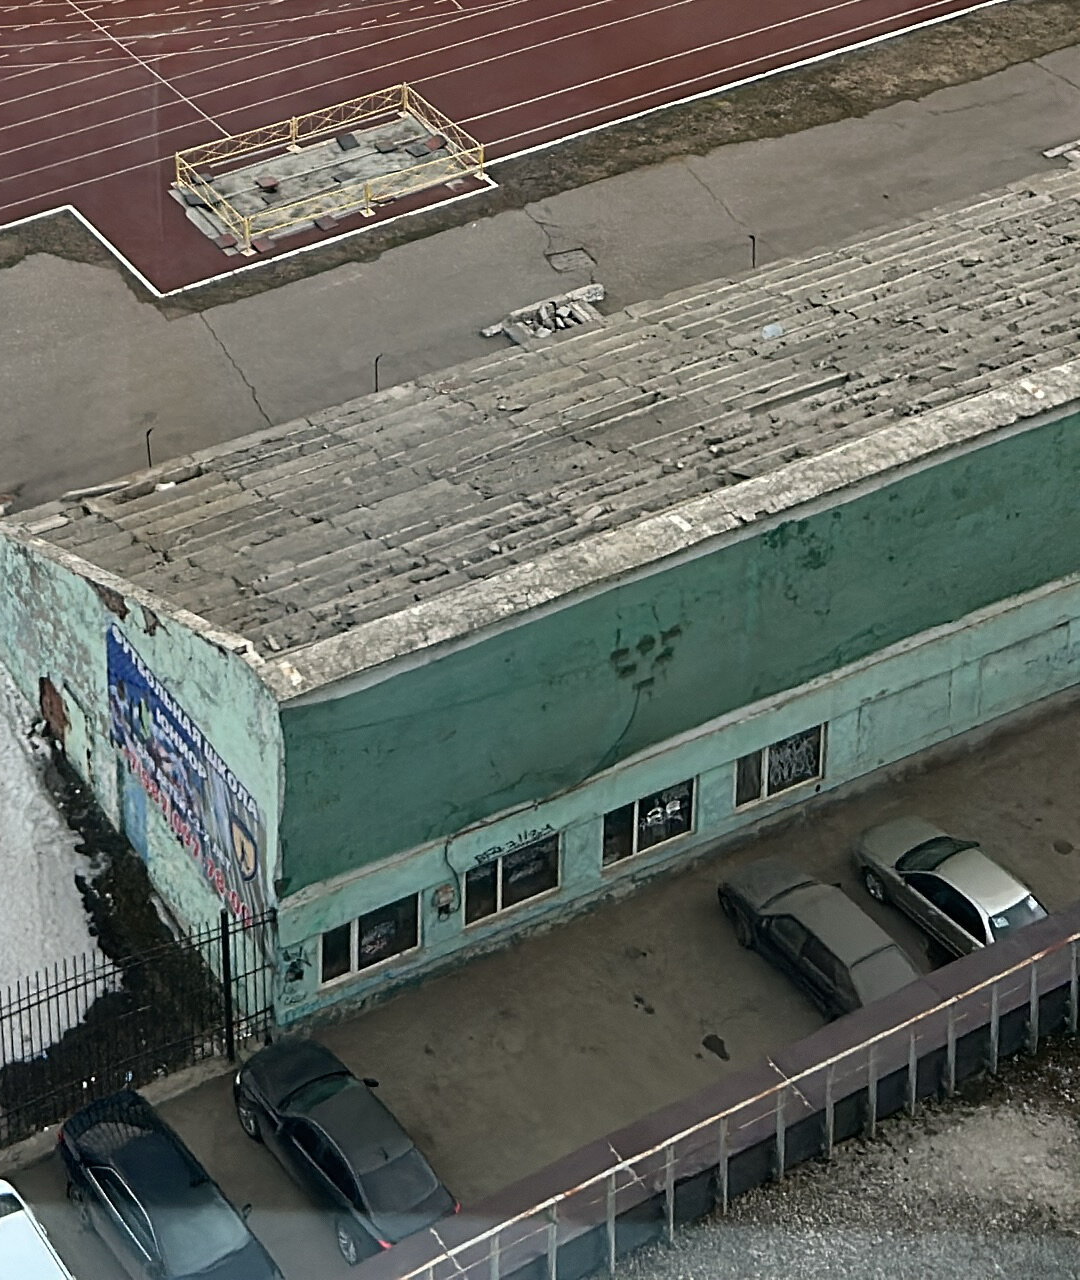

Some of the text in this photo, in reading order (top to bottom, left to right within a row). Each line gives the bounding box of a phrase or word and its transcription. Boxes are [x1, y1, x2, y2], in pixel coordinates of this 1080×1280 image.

[110, 621, 258, 823] ФУТБОЛЬНАЯ ШКОЛА
[155, 704, 207, 784] ЮНИОР
